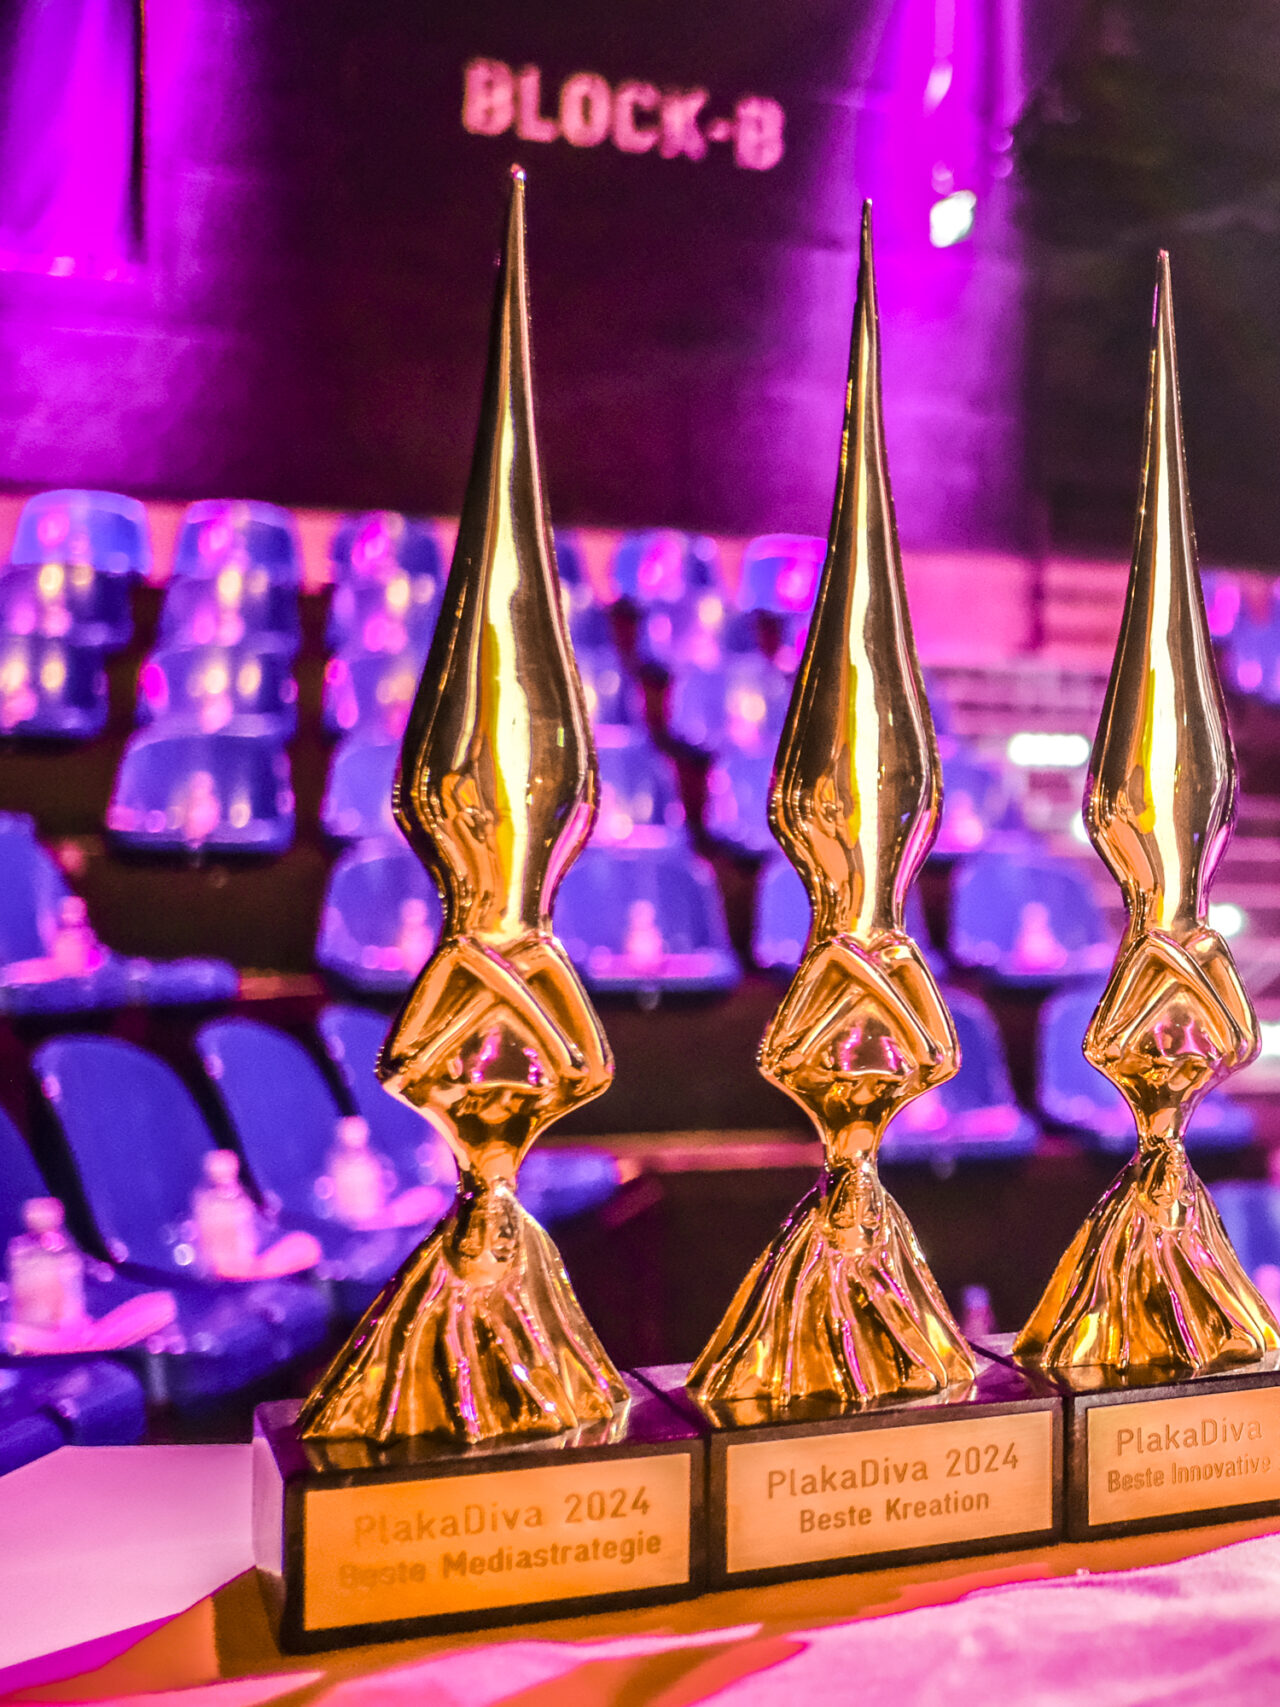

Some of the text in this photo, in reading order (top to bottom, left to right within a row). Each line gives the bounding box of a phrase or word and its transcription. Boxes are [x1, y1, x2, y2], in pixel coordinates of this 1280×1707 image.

[463, 57, 785, 171] BLOCK-B
[1117, 1417, 1263, 1456] PlakaDiva
[767, 1442, 1018, 1499] PlakaDiva 2024
[1107, 1467, 1164, 1493] Beste
[1172, 1453, 1271, 1484] Innovative
[353, 1485, 651, 1548] PlakaDiva 2024
[800, 1490, 990, 1533] Beste Kreation
[338, 1530, 662, 1589] Beste Mediastrategie
